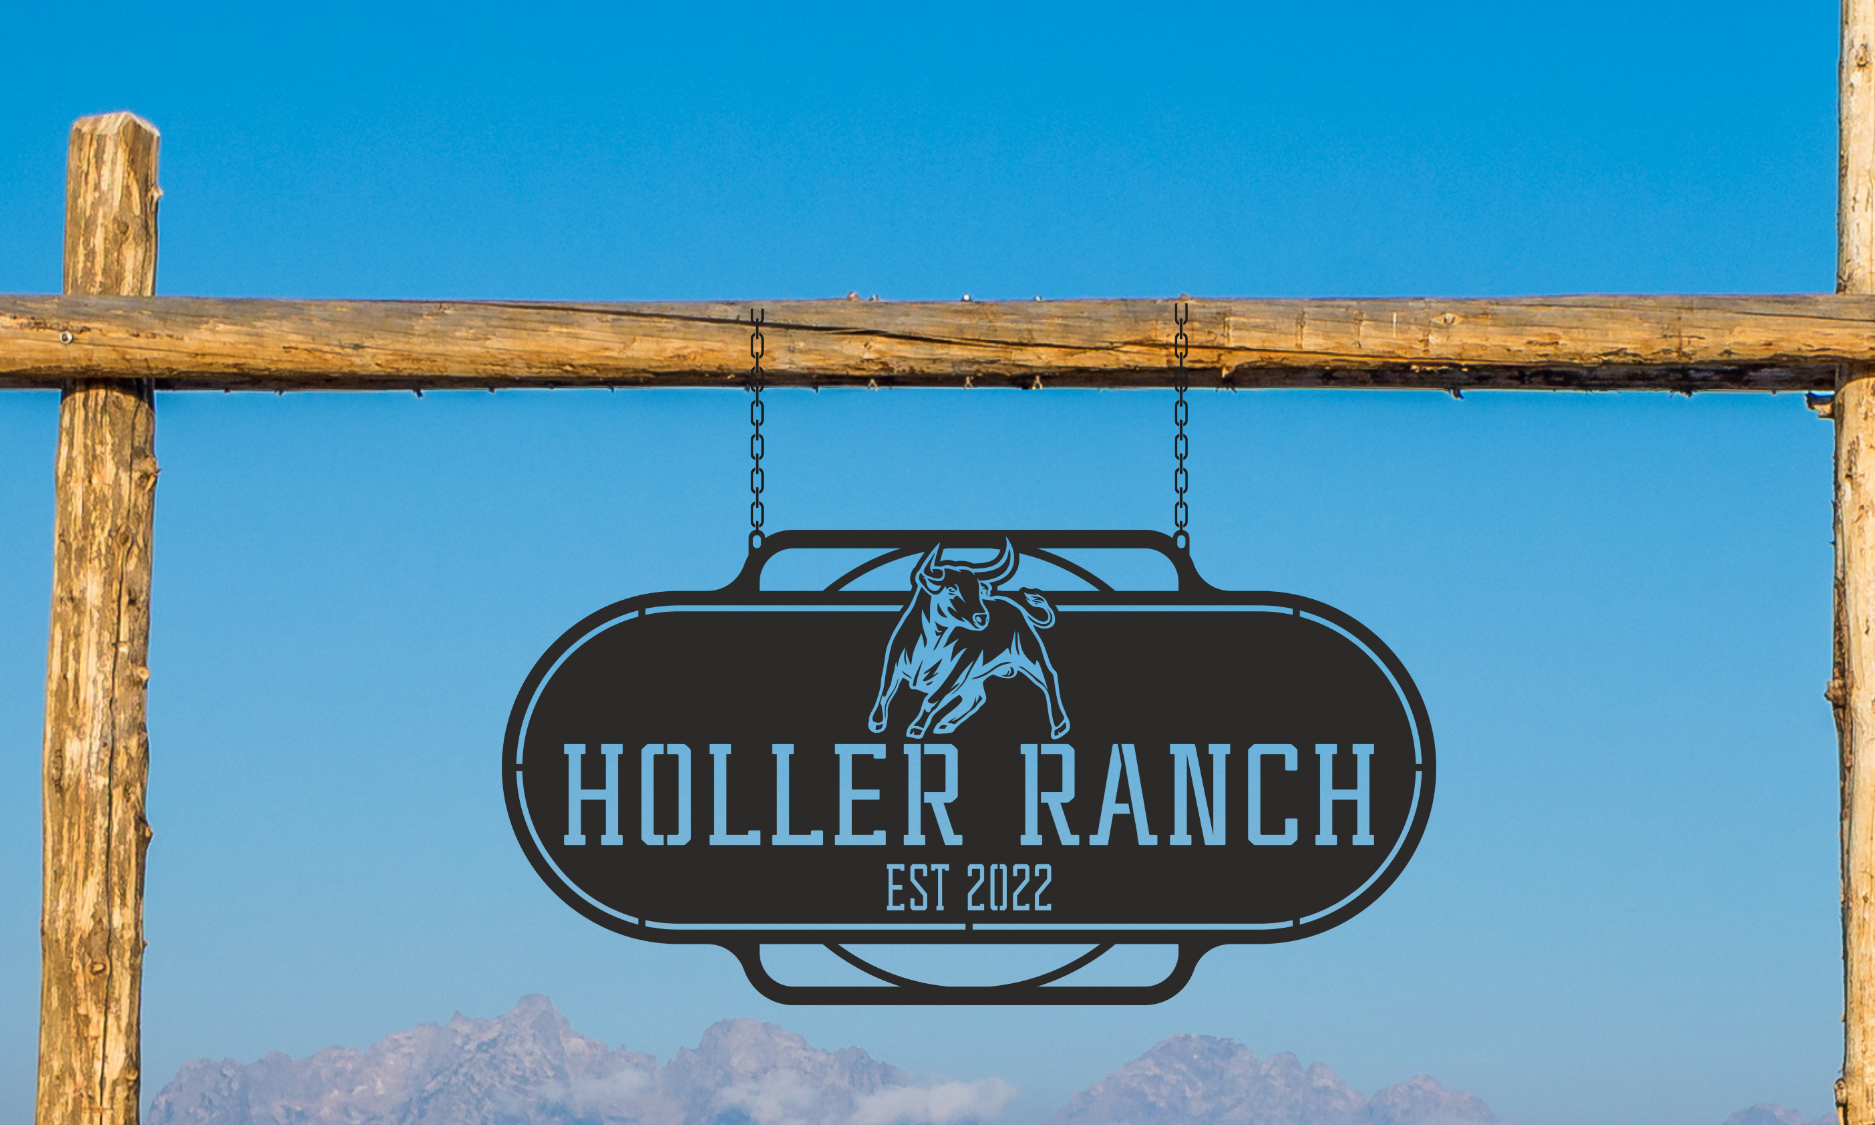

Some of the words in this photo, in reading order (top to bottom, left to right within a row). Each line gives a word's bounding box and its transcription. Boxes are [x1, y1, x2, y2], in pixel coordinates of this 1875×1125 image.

[563, 744, 963, 846] HOLLER
[1021, 744, 1374, 846] RANCH
[887, 864, 949, 910] EST
[968, 864, 1052, 910] 2022
